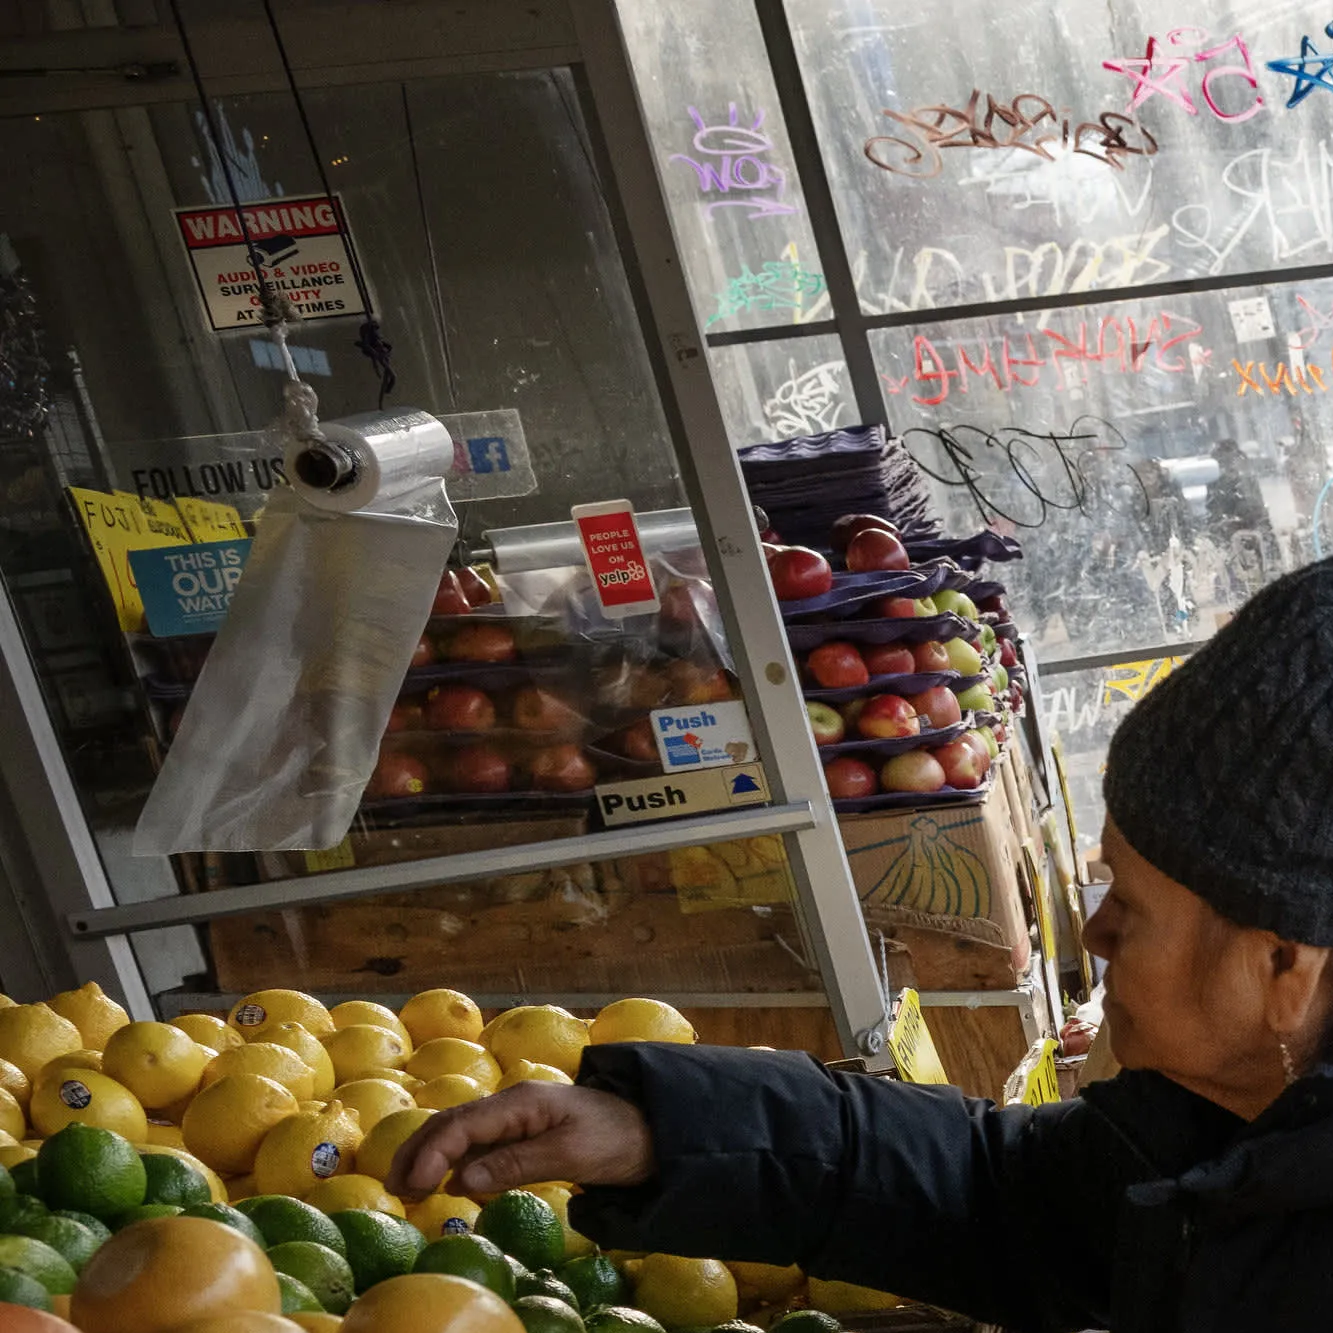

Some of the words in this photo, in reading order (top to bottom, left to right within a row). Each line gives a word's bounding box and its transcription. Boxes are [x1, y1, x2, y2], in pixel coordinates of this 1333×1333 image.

[185, 203, 337, 241] WARNING
[217, 269, 269, 285] AUDIO
[273, 267, 287, 278] &
[289, 261, 341, 277] VIDEO
[220, 274, 345, 297] SURVEILLANCE
[288, 289, 322, 302] UTY
[236, 309, 255, 322] AT
[132, 460, 248, 500] FOLLOW
[251, 457, 290, 491] US
[83, 500, 142, 536] FUJI
[589, 529, 630, 542] PEOPLE
[591, 543, 618, 554] LOVE
[620, 541, 635, 550] US
[163, 552, 216, 572] THIS
[219, 549, 241, 566] IS
[608, 555, 625, 564] ON
[171, 567, 243, 597] OUR
[599, 569, 630, 587] yelp
[177, 593, 236, 614] WATC
[658, 711, 717, 732] Push
[601, 785, 688, 815] Push
